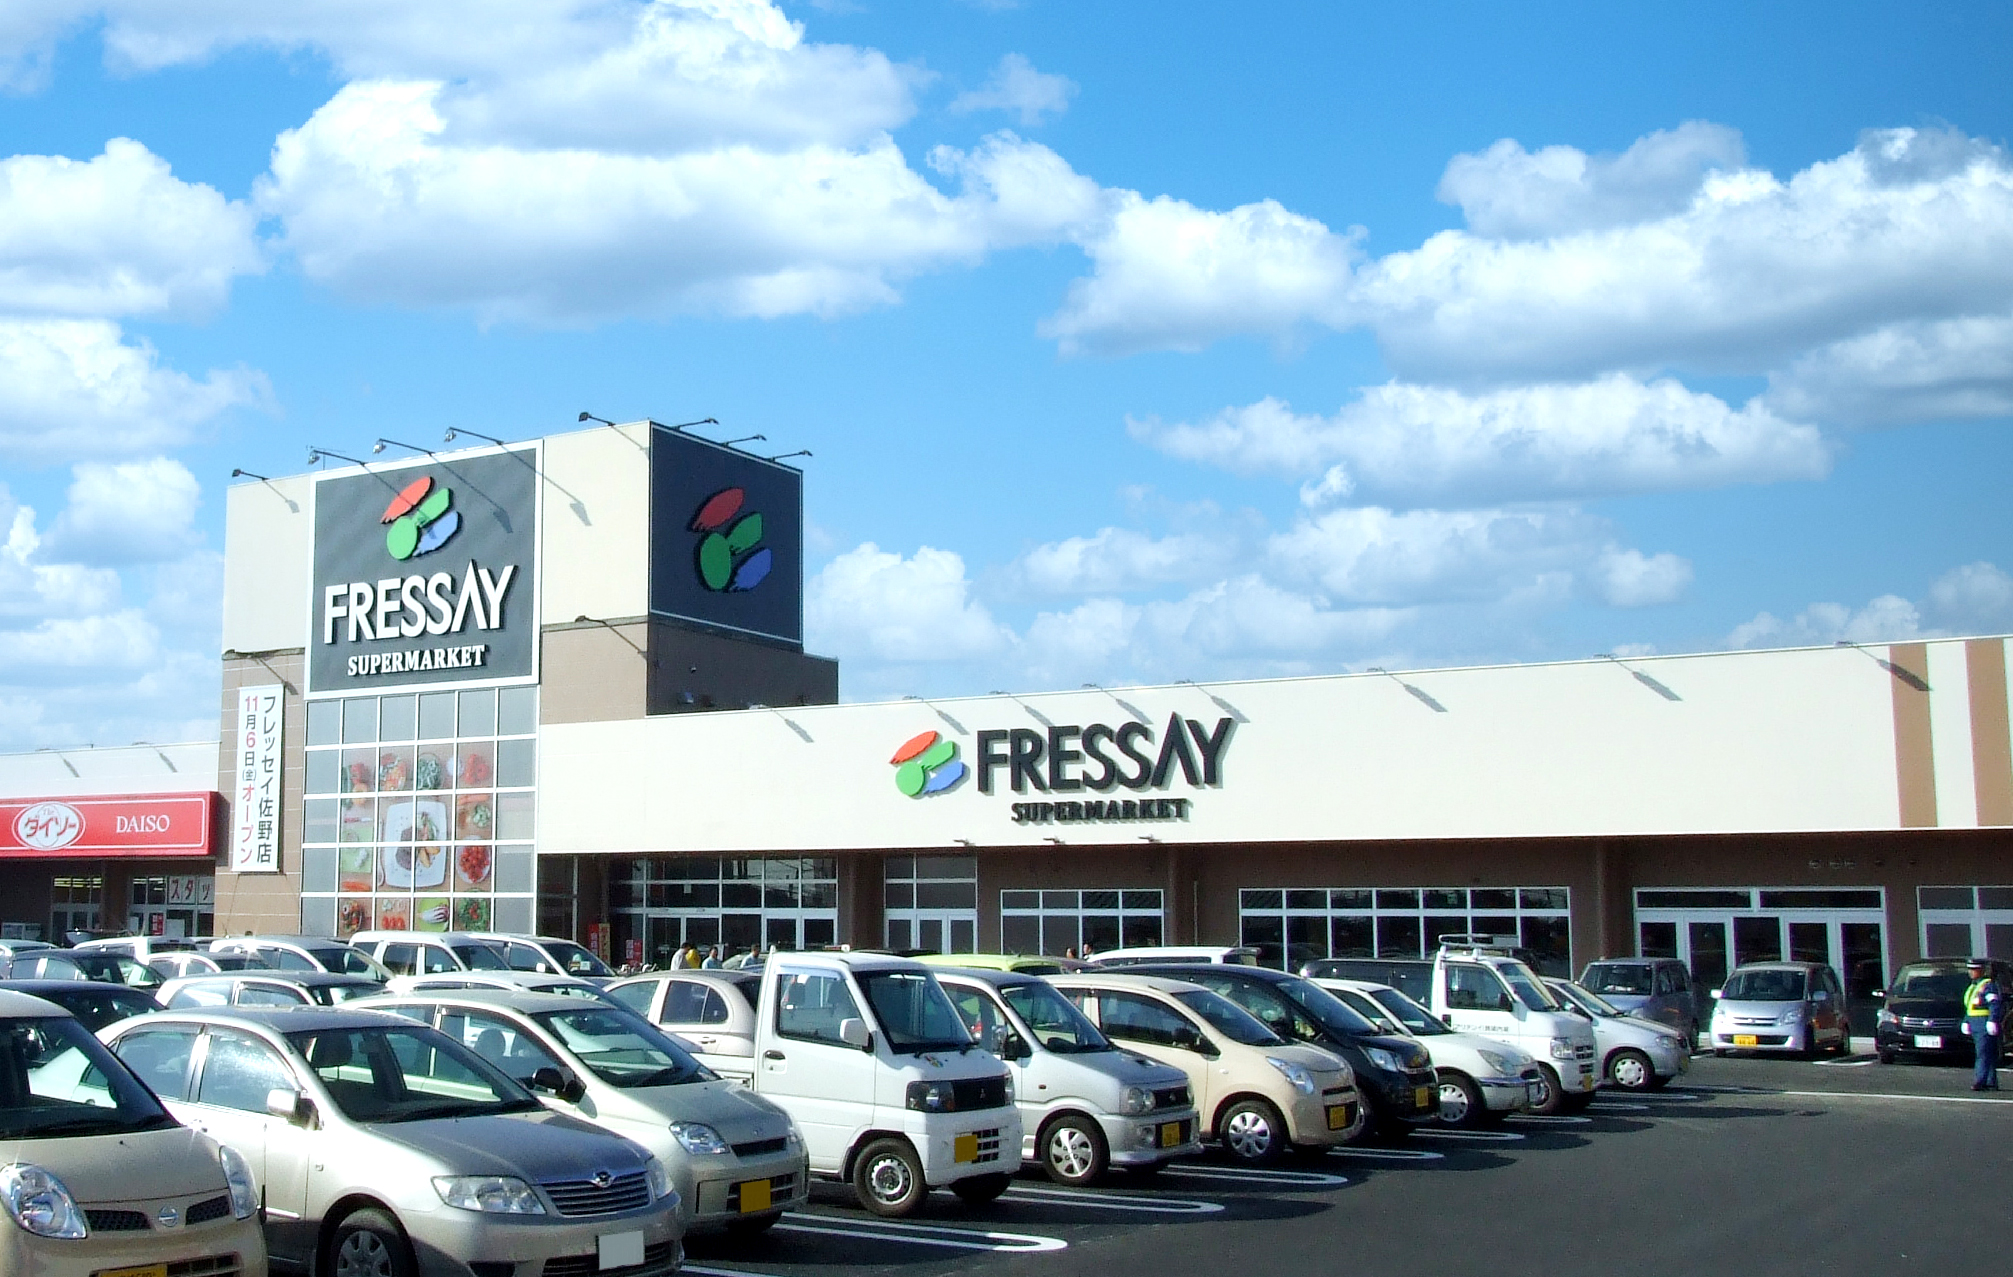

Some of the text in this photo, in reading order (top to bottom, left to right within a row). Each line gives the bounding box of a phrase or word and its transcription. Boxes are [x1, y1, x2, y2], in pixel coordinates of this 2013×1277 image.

[324, 560, 517, 645] FRESSAY
[347, 644, 486, 677] SUPERMARKET
[977, 711, 1234, 792] FRESSAY
[257, 696, 276, 863] フレッセイ佐野店
[24, 815, 77, 838] ダイソー
[116, 815, 170, 833] DAISO
[1011, 798, 1190, 823] SUPERMARKET
